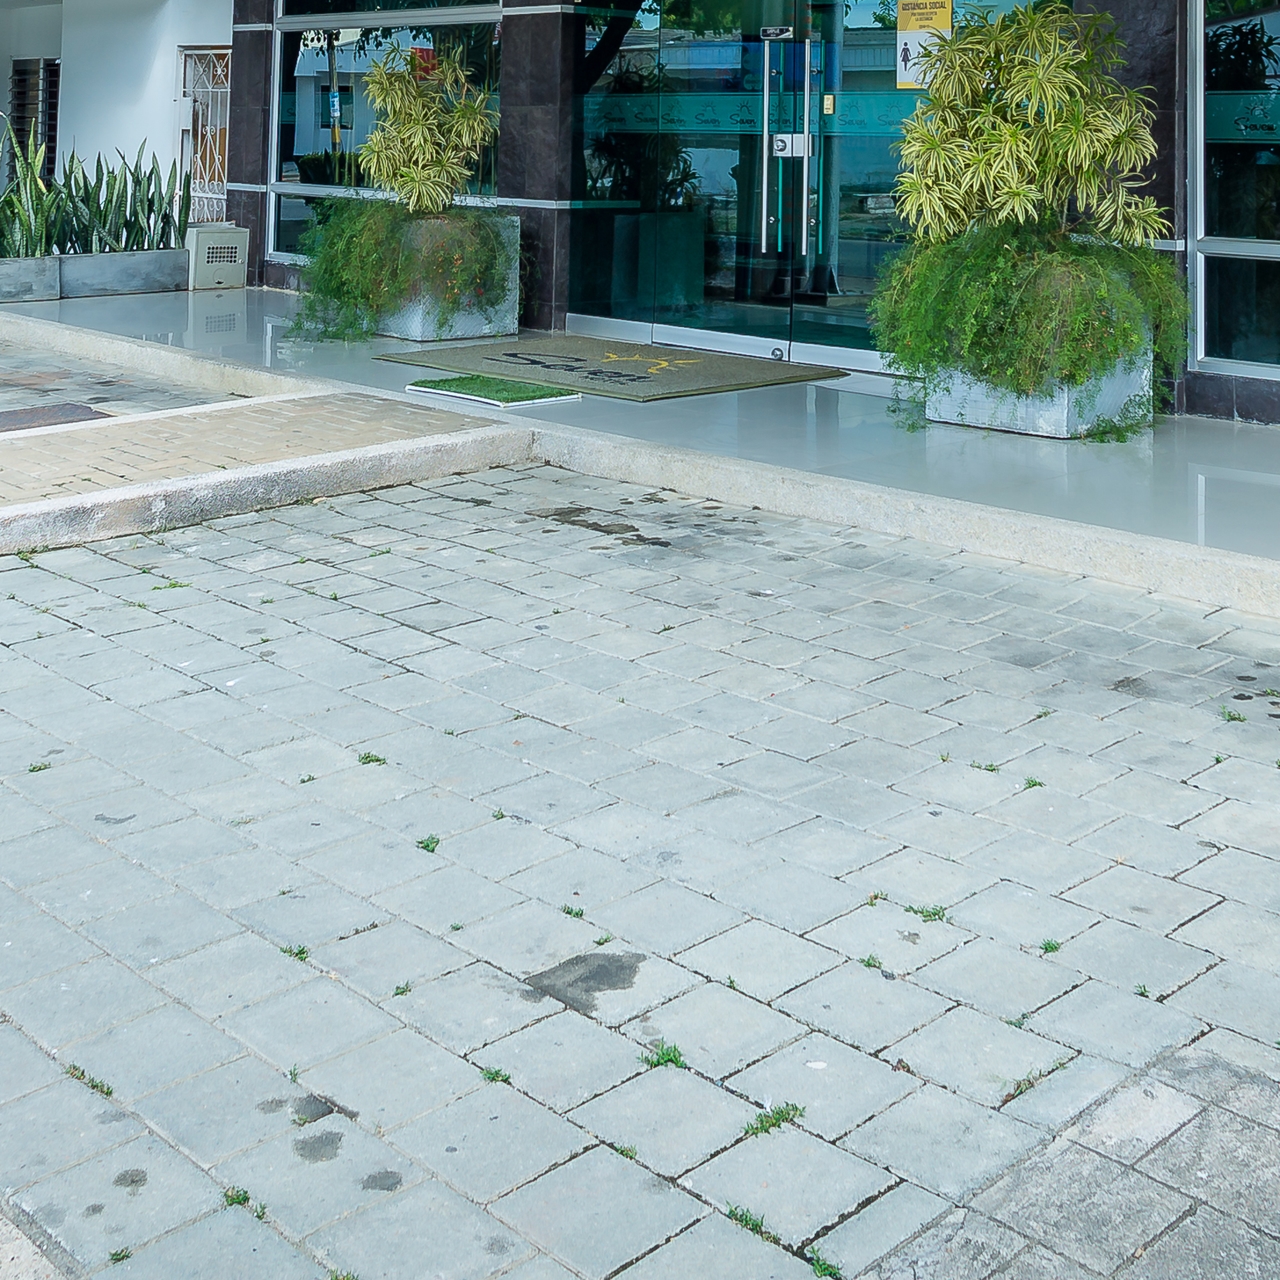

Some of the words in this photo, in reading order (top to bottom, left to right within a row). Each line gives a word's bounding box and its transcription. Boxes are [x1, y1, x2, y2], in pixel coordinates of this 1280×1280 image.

[929, 1, 947, 9] SOCIAL
[729, 113, 757, 126] Seven
[1234, 116, 1277, 132] Seven
[482, 352, 652, 382] Seven
